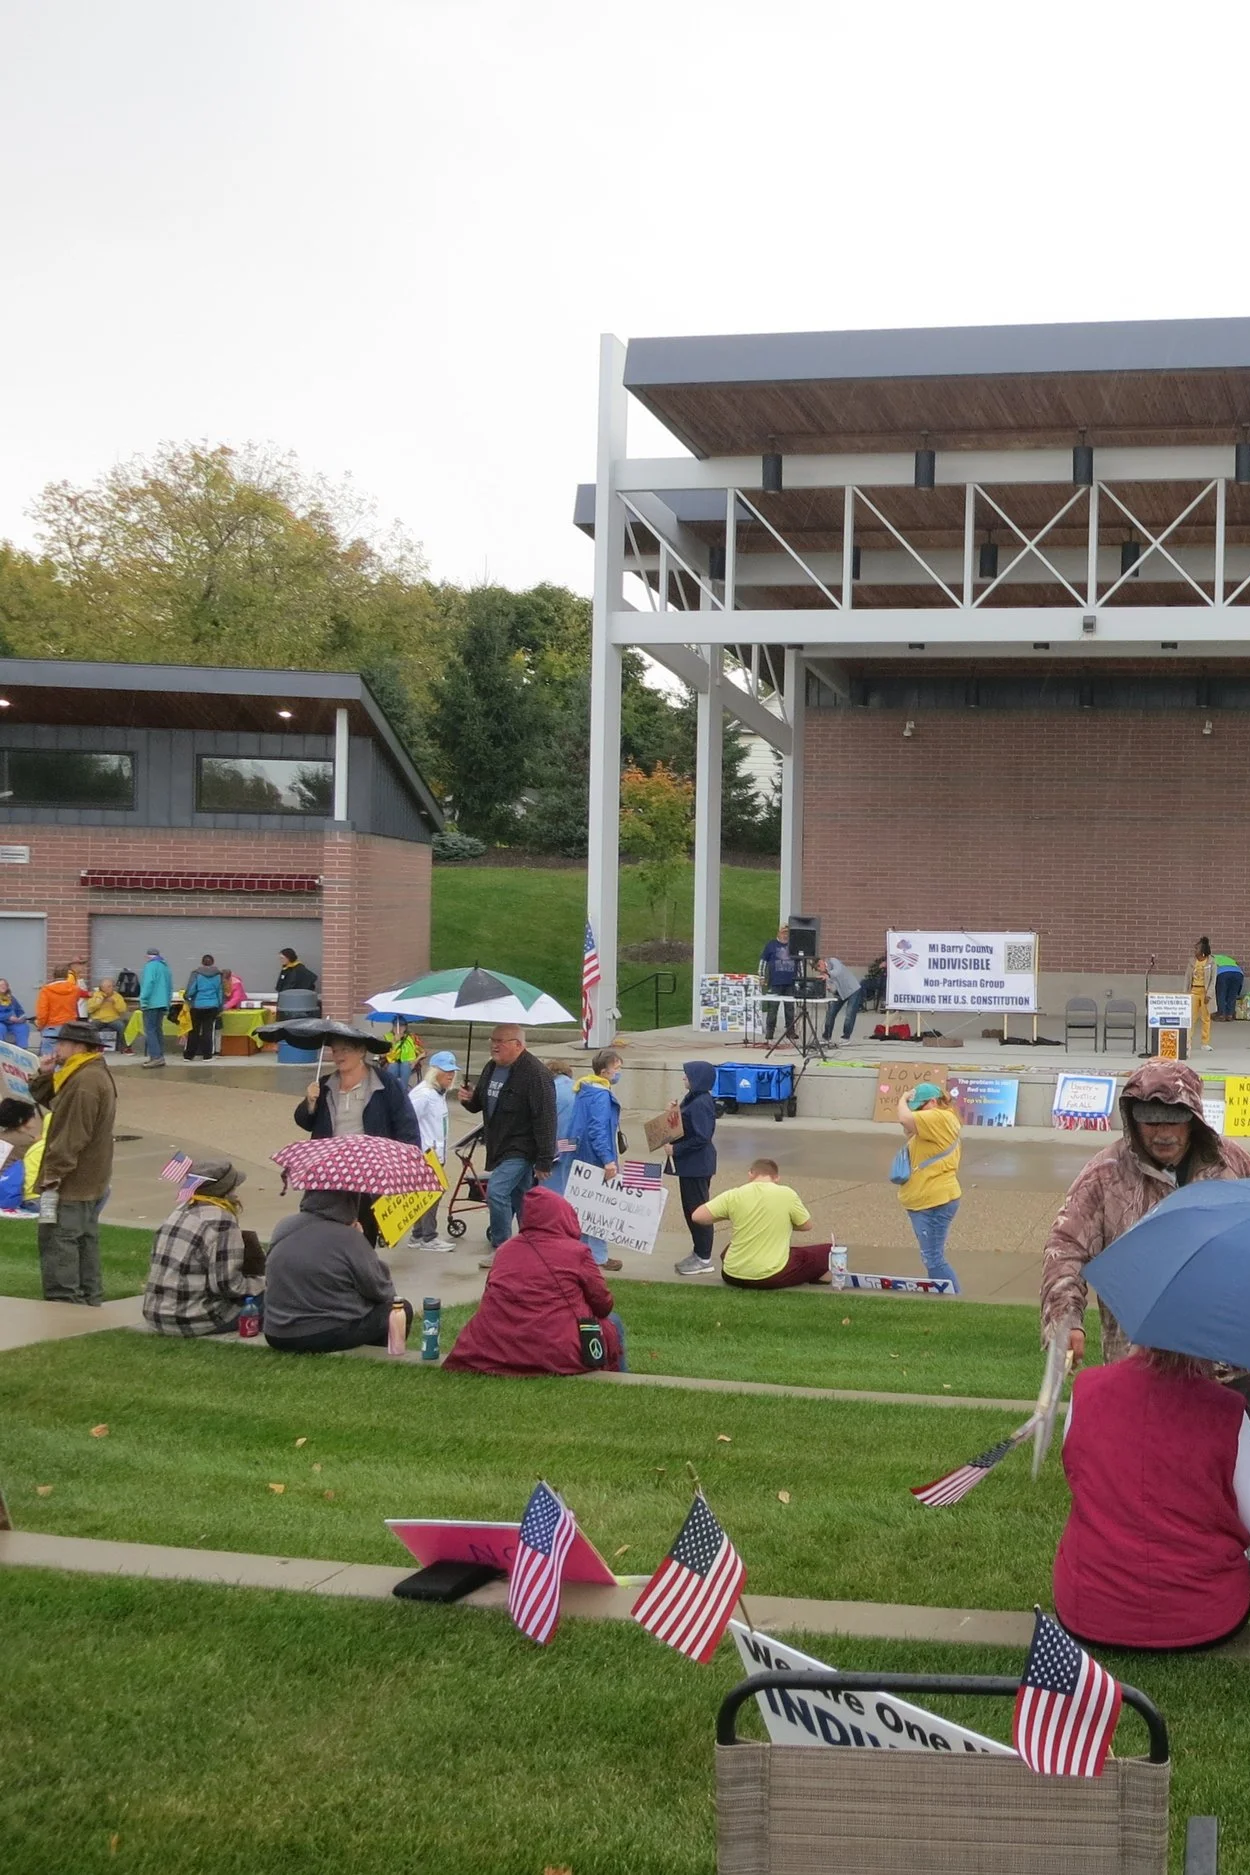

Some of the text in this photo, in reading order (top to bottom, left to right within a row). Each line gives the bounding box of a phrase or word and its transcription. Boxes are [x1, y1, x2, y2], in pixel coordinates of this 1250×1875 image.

[929, 944, 993, 954] MI Barry County
[928, 958, 990, 970] INDIVISIBLE
[924, 978, 1004, 989] Non-Partisan Group
[894, 994, 1030, 1006] DEFENDING THE U.S. CONSTITUTION
[574, 1164, 644, 1198] NO KINGS
[397, 1192, 434, 1231] ENEMIES
[582, 1210, 626, 1234] UNLAWFUL
[876, 1702, 952, 1751] One
